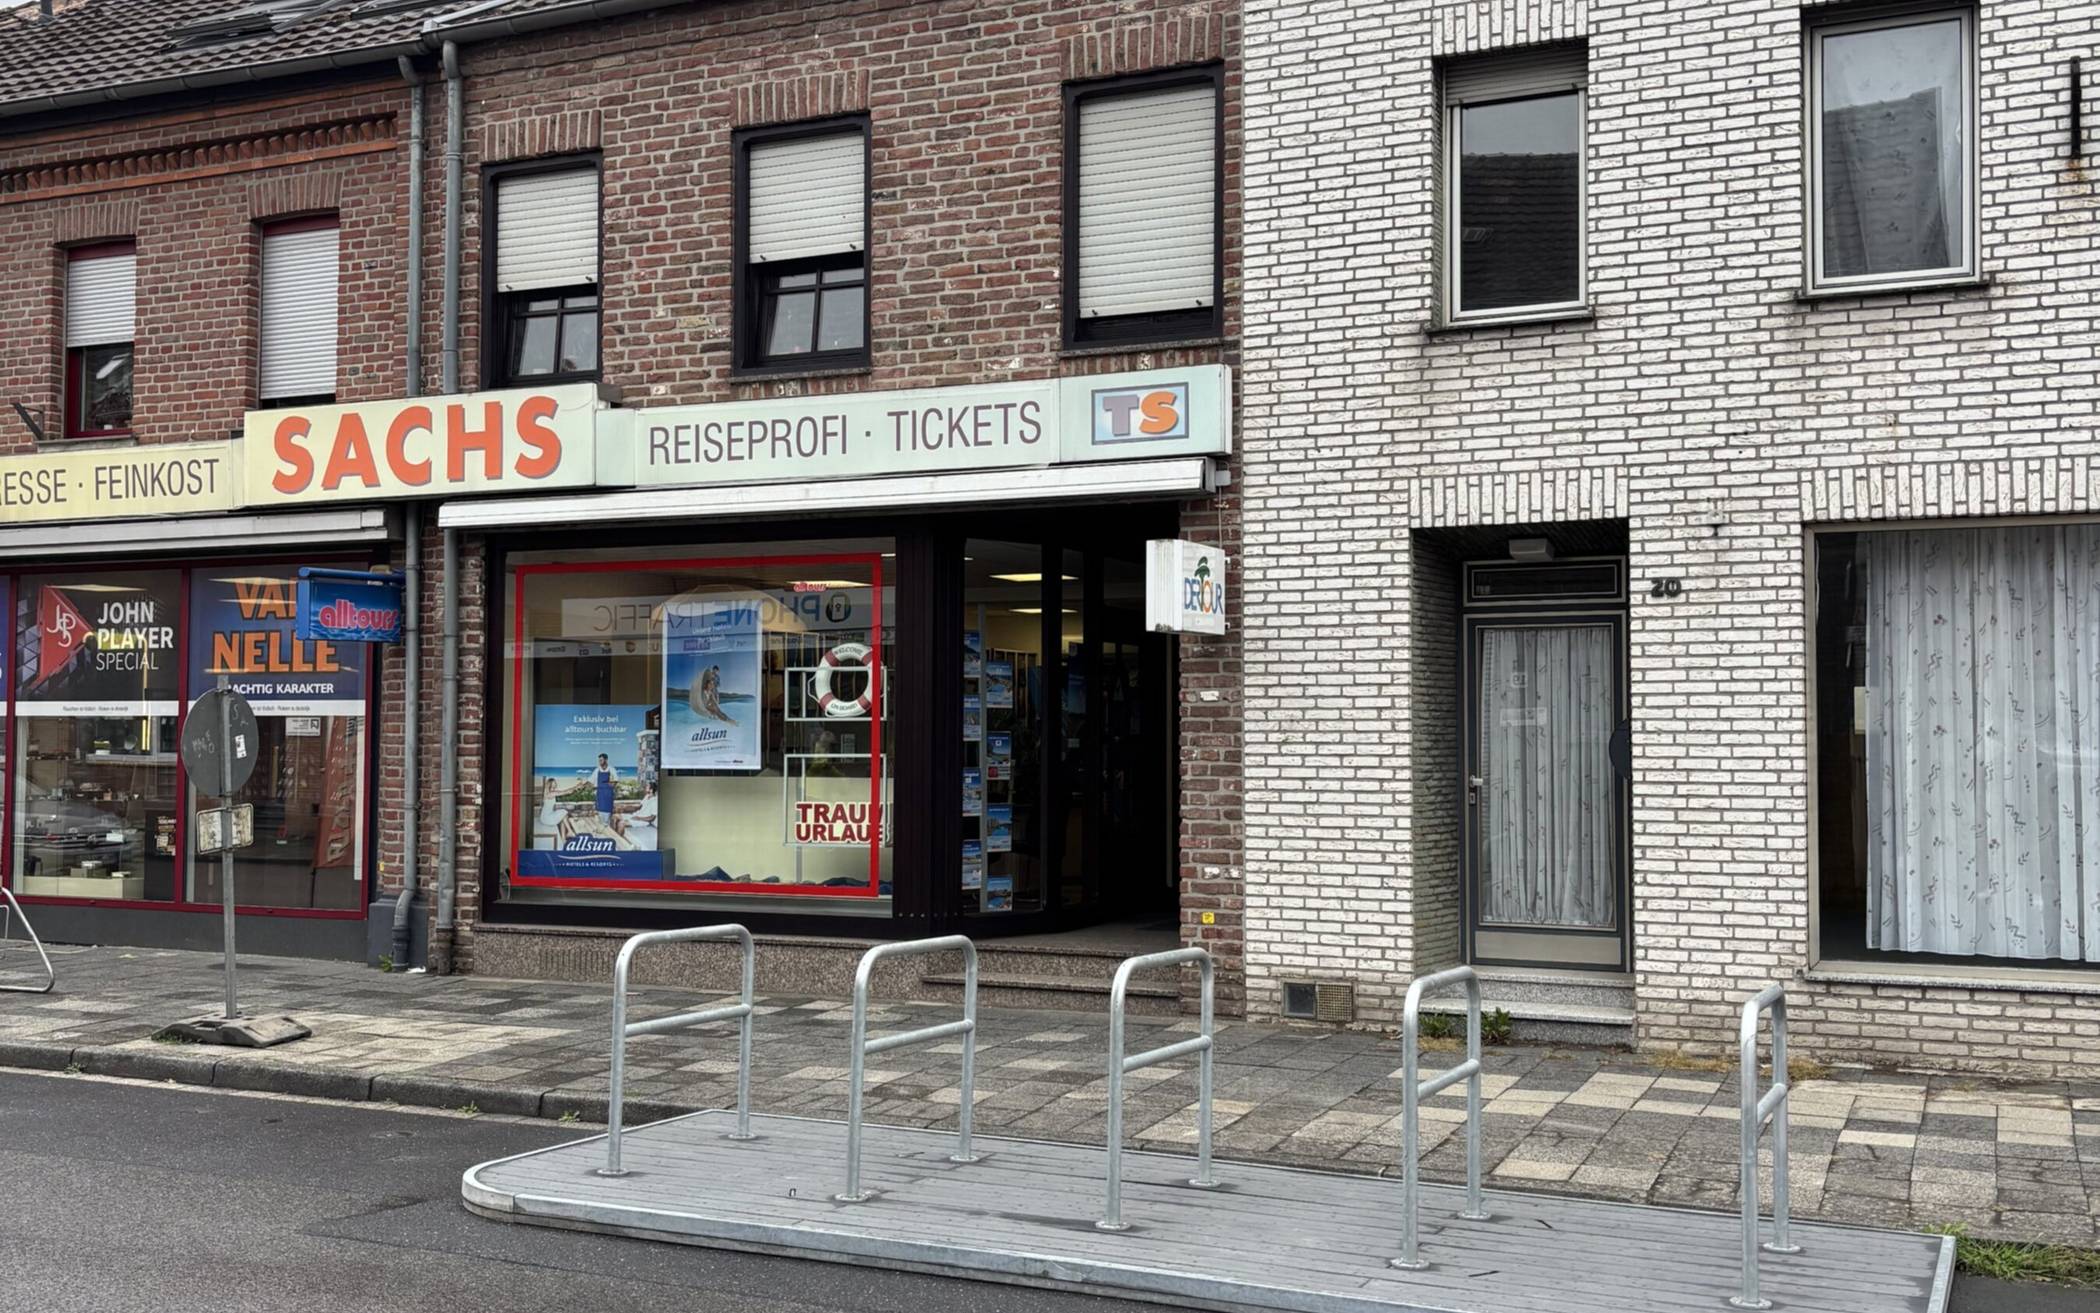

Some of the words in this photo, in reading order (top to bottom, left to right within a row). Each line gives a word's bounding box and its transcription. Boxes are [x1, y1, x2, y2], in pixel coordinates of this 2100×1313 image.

[1102, 391, 1180, 437] TS
[272, 396, 562, 494] SACHS
[650, 415, 847, 465] REISEPROFI
[887, 400, 1041, 451] TICKETS
[0, 469, 67, 505] ESSE
[95, 459, 219, 500] FEINKOST
[234, 577, 297, 620] VA
[1184, 577, 1223, 615] DERTOUR
[1651, 577, 1682, 598] 20
[97, 601, 154, 624] JOHN
[320, 599, 398, 629] alltours
[97, 627, 174, 650] PLAYER
[212, 631, 340, 673] NELLE
[95, 652, 159, 671] SPECIAL
[276, 683, 334, 694] KARAKTER
[691, 728, 728, 742] allsun
[565, 836, 613, 851] allsun
